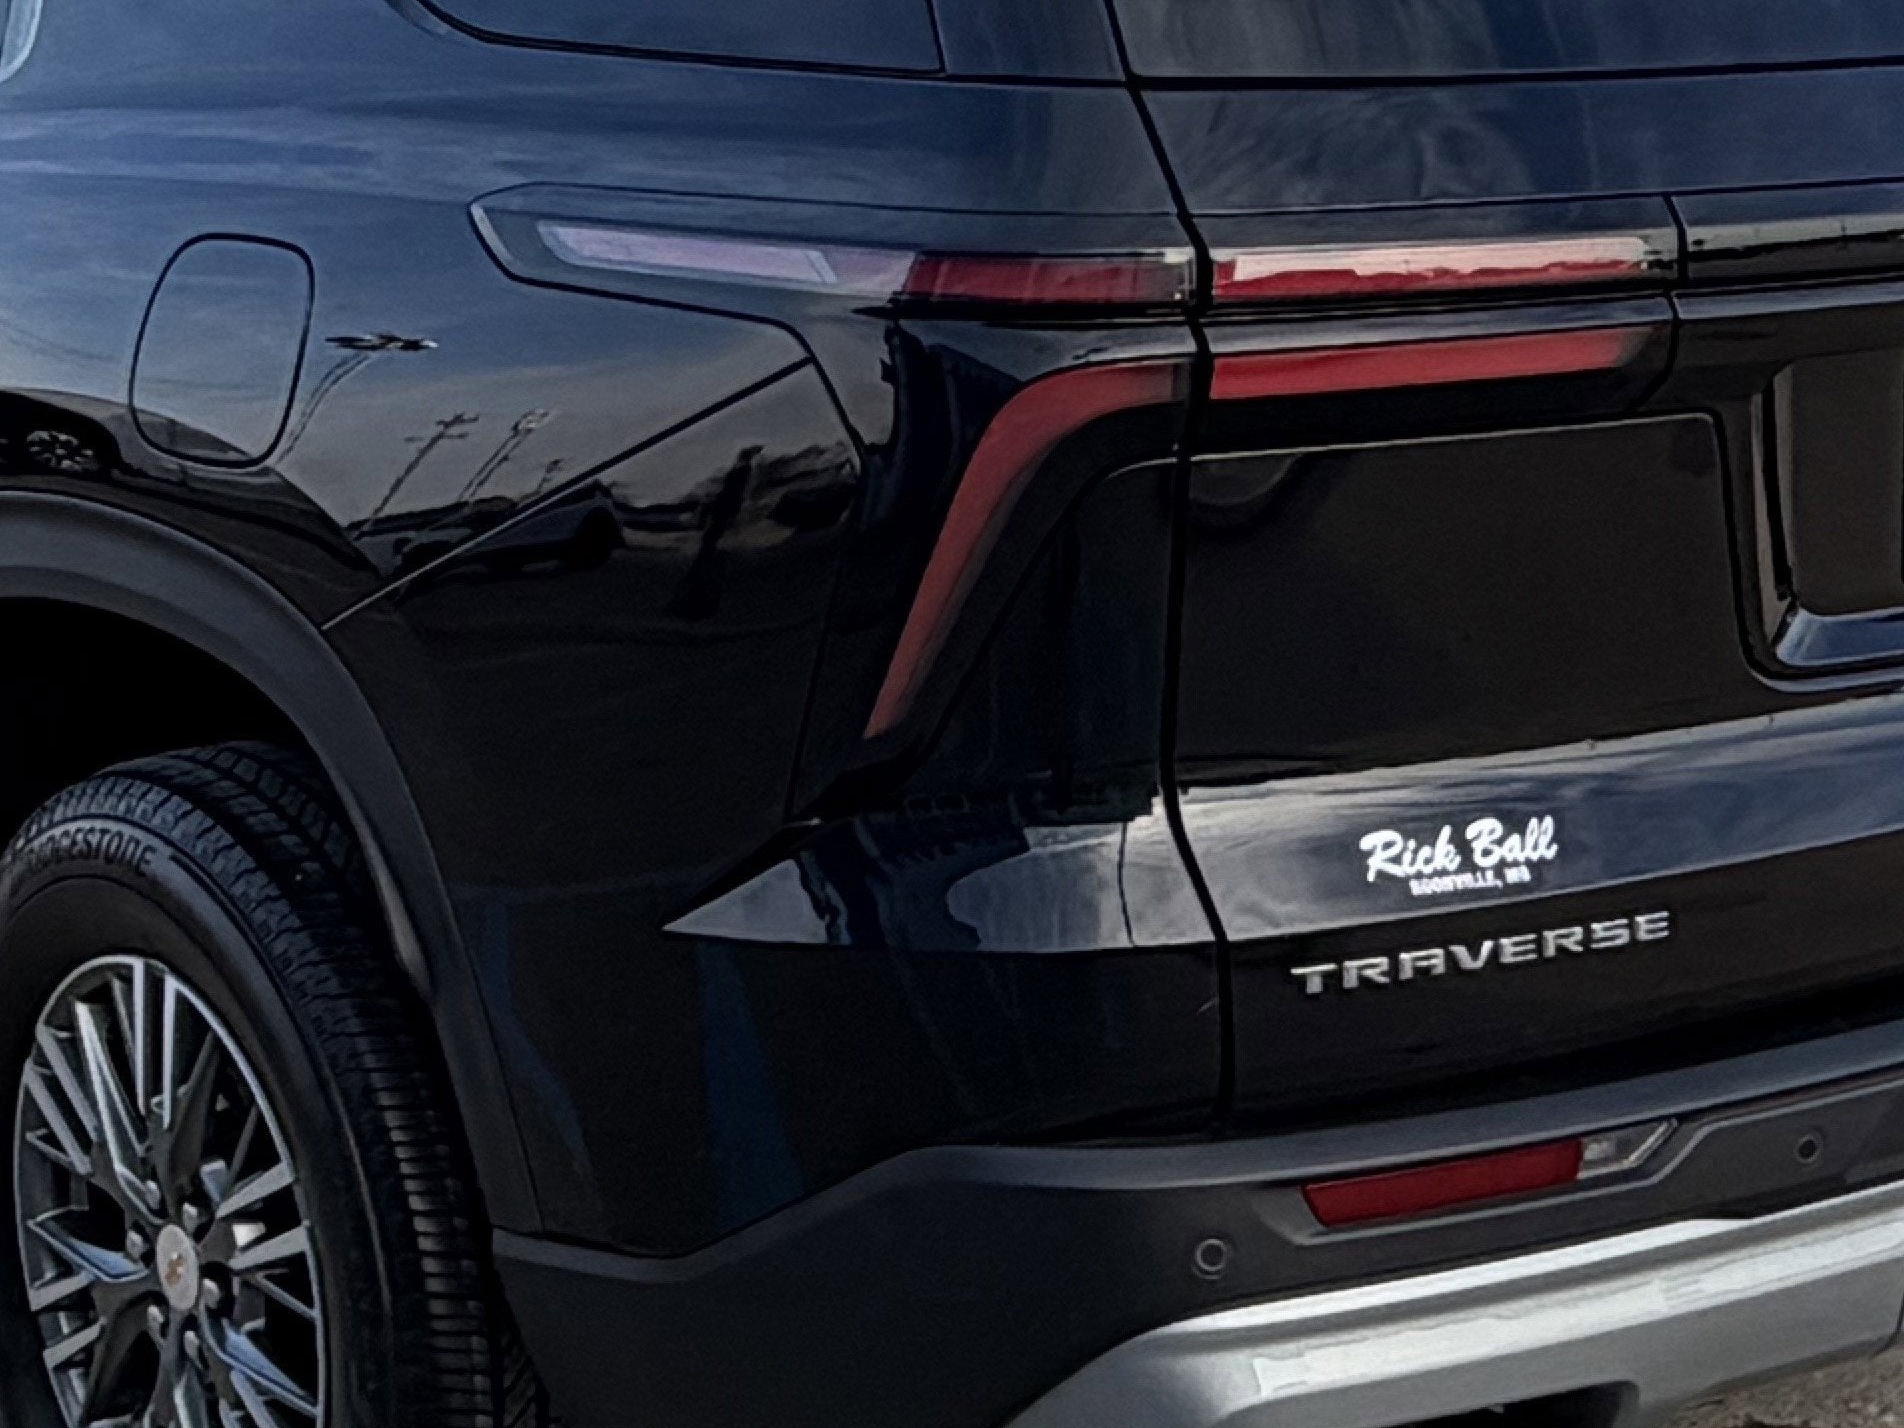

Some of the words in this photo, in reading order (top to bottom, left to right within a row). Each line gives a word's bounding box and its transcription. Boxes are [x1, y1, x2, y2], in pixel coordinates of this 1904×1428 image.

[1359, 824, 1462, 883] Rick
[1465, 815, 1559, 868] Ball
[1290, 910, 1671, 995] TRAVERSE
